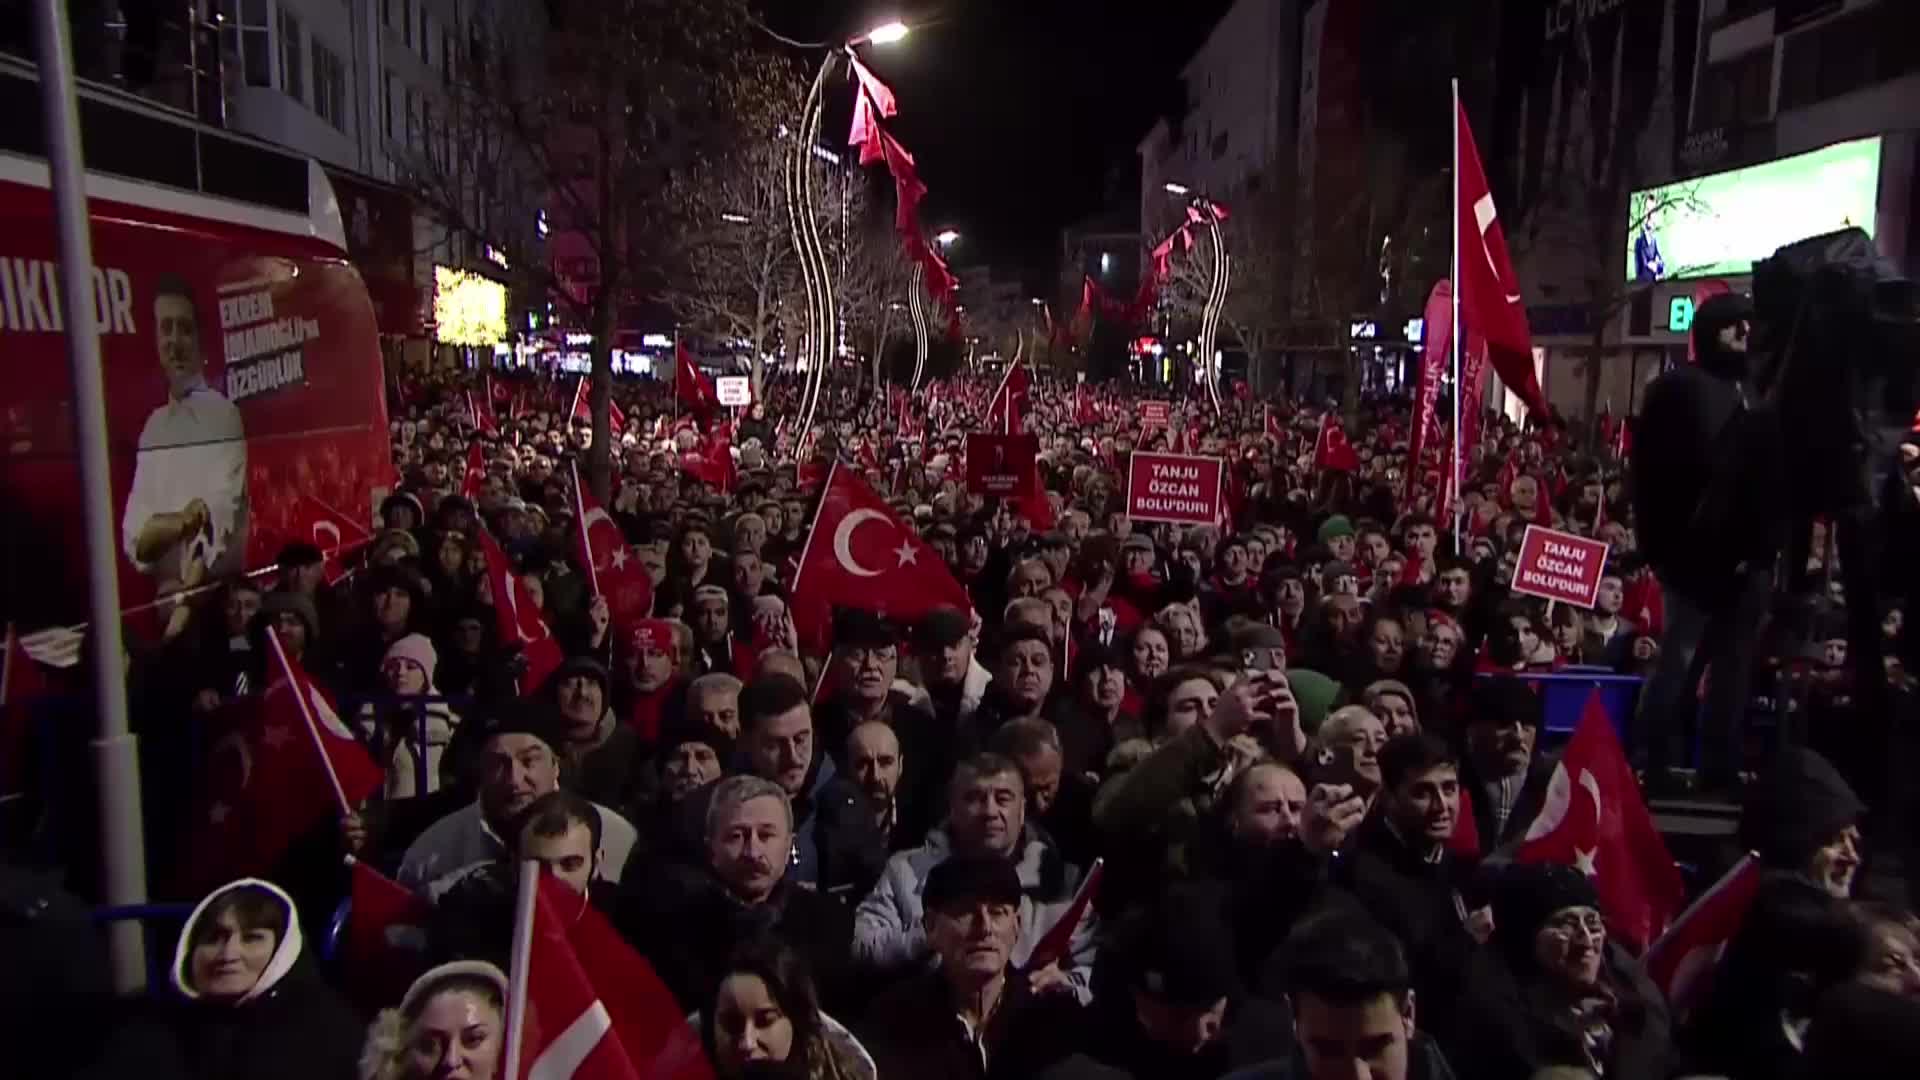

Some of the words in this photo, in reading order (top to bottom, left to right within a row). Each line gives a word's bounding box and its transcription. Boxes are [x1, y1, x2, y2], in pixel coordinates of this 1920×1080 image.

[1151, 464, 1199, 479] TANJU
[1149, 479, 1200, 497] ÖZCAN
[1543, 540, 1586, 561] TANJU
[1536, 554, 1584, 579] ÖZCAN
